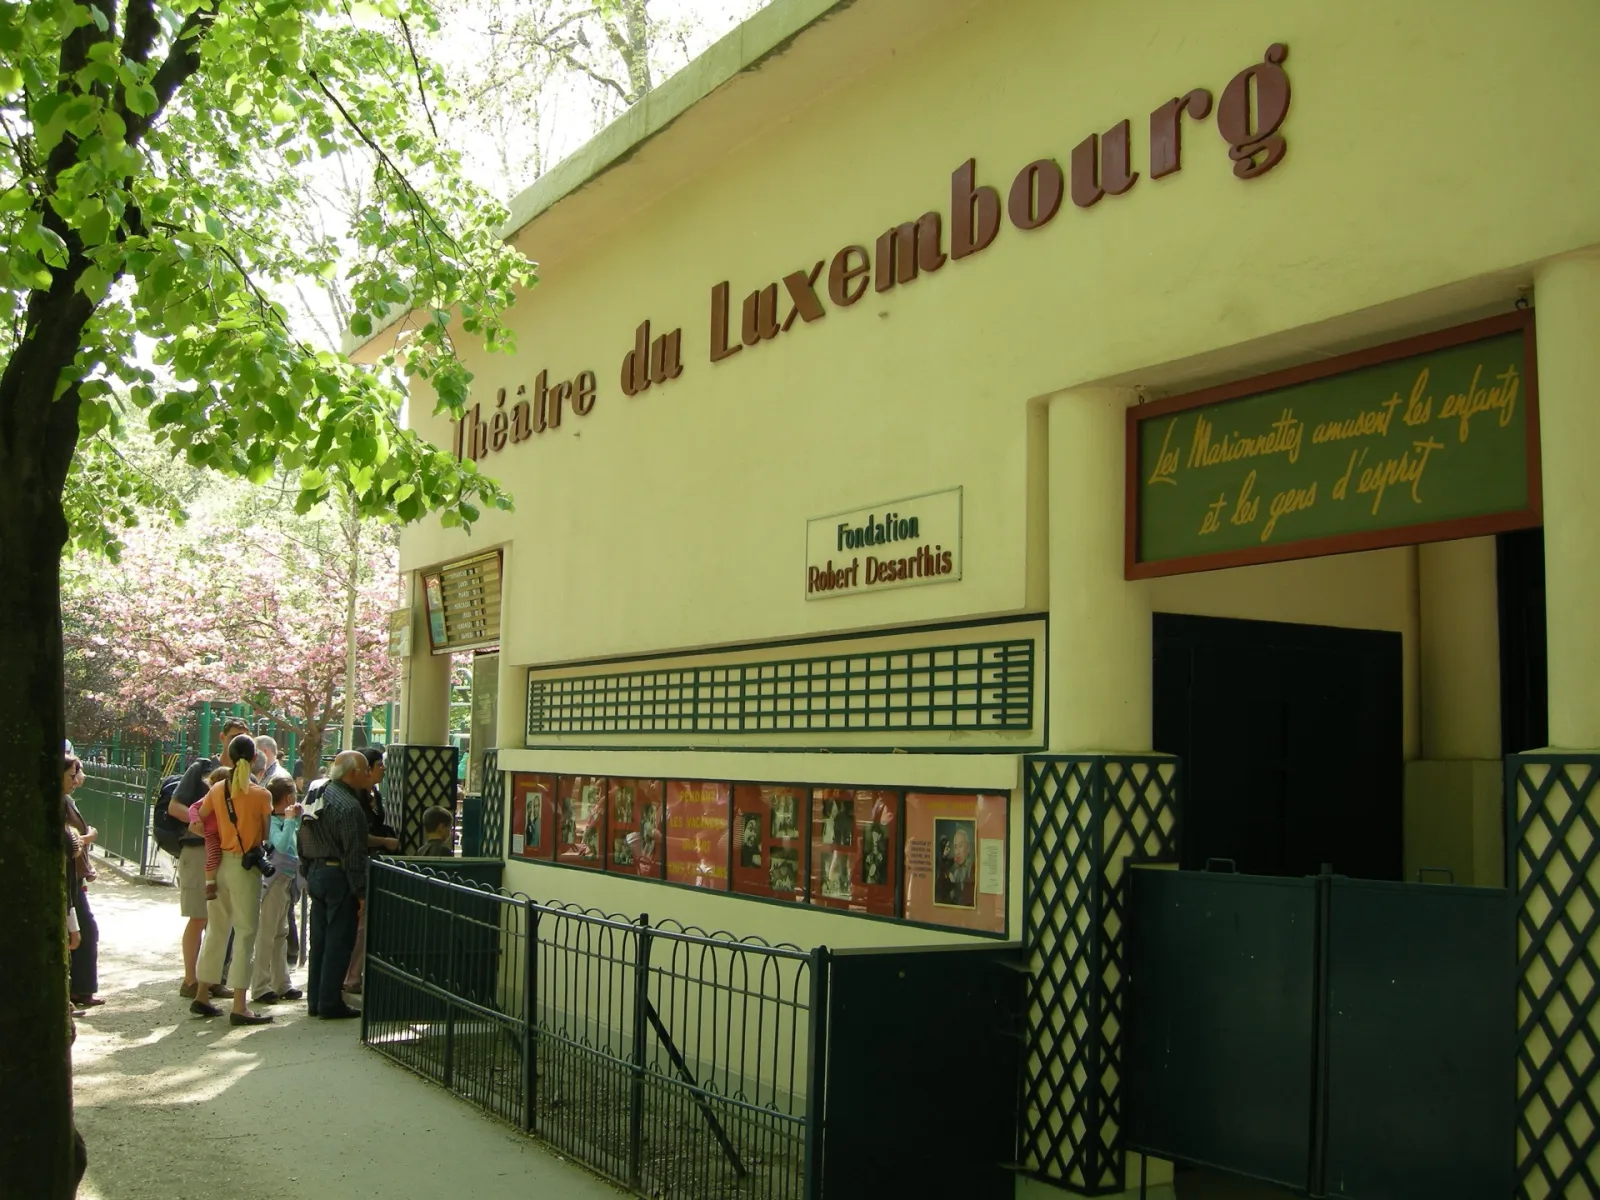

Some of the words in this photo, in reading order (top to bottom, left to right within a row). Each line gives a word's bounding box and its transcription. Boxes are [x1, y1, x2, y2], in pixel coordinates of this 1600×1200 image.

[449, 368, 597, 464] Théâtre
[620, 319, 684, 396] du
[709, 42, 1292, 363] Luxembourg
[1147, 416, 1181, 486] Les
[1186, 407, 1305, 464] Marionnettes
[1311, 391, 1403, 445] amusent
[1402, 367, 1433, 427] les
[1436, 363, 1521, 444] enfants
[1198, 492, 1228, 537] et
[1229, 469, 1260, 525] les
[1260, 481, 1318, 543] gens
[1332, 435, 1446, 516] d'esprit
[807, 559, 860, 594] Robert
[865, 544, 953, 585] Desarthis
[837, 512, 920, 552] Fondation
[670, 816, 683, 829] LES
